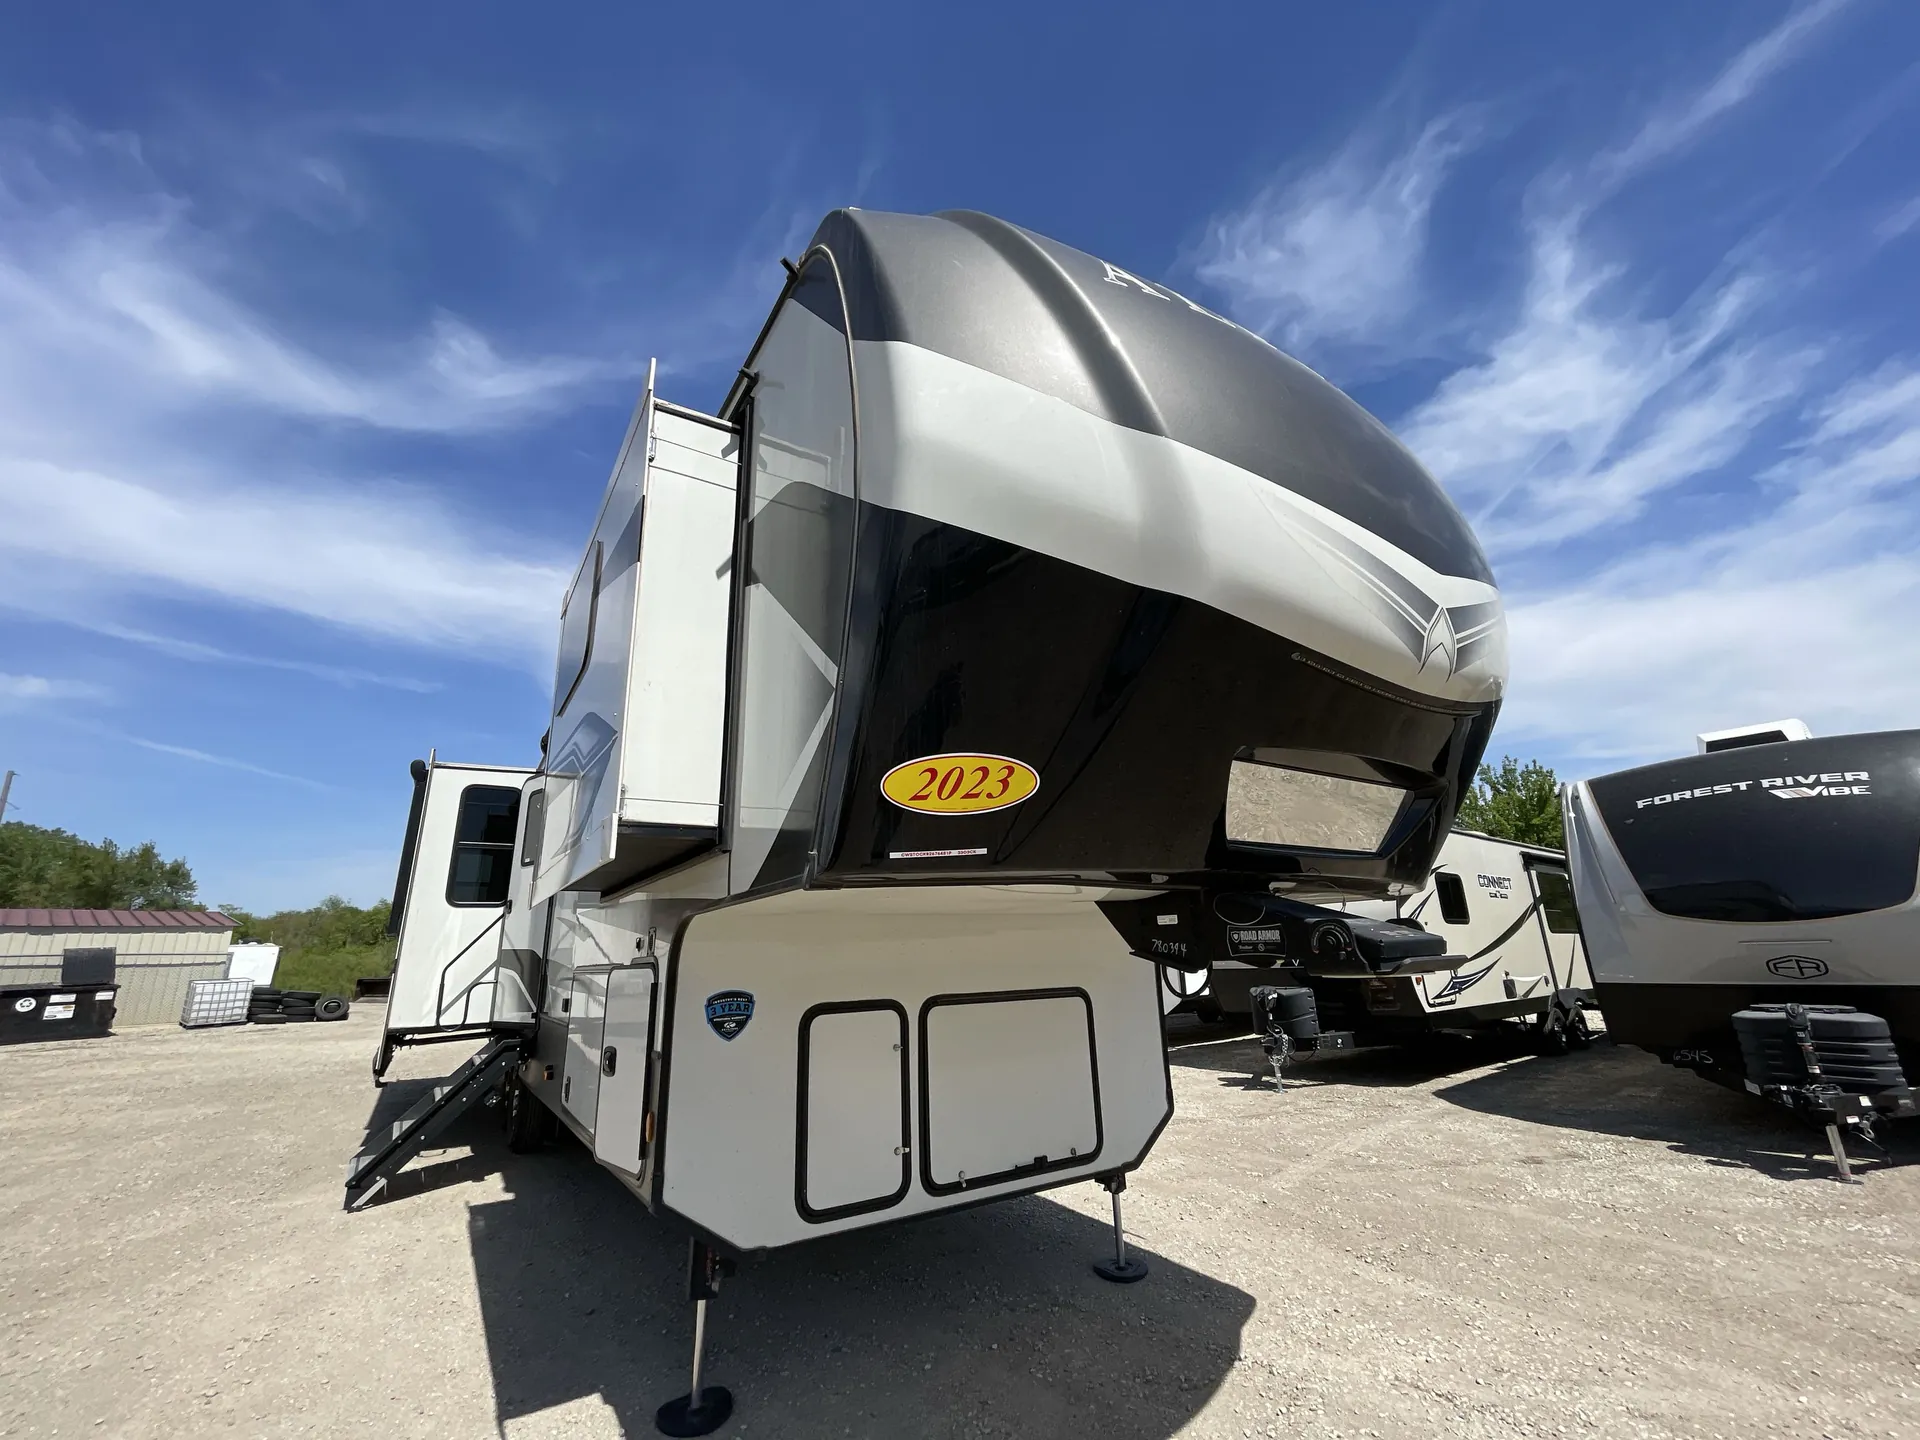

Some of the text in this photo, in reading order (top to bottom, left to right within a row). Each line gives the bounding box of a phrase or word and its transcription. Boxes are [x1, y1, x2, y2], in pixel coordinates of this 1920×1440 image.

[908, 765, 1015, 801] 2023
[1636, 771, 1871, 809] FOREST RIVER
[1769, 785, 1872, 799] VIBE
[1477, 874, 1512, 890] CONNECT
[1240, 930, 1280, 941] ROAD ARMOR
[710, 1003, 750, 1016] 3 YEAR
